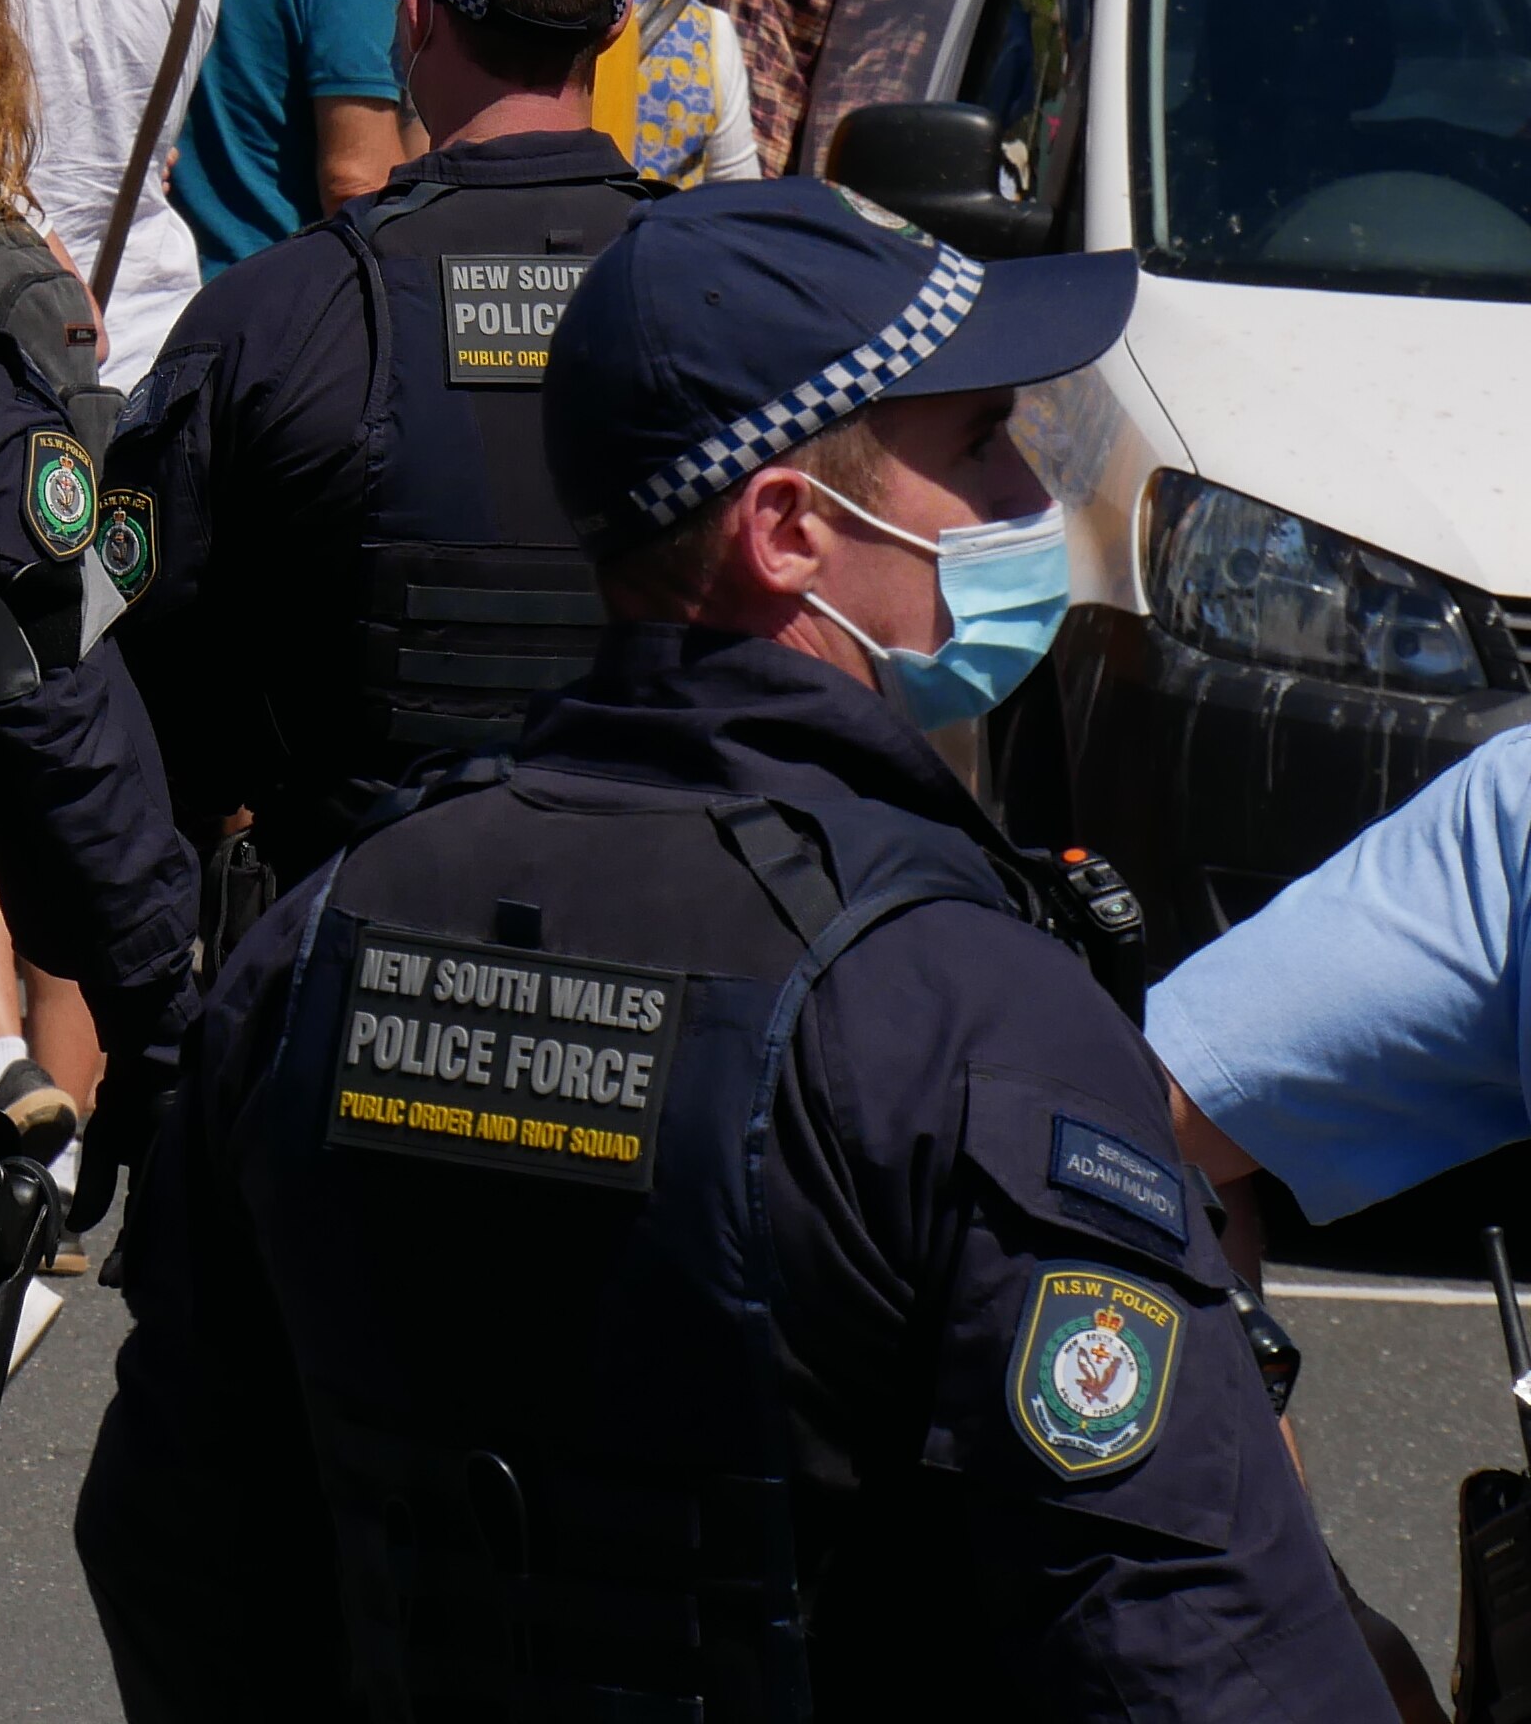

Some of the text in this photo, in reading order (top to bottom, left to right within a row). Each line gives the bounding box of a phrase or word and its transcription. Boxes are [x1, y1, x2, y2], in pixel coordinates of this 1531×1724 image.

[452, 265, 588, 292] NEW SOUT
[458, 350, 549, 368] PUBLIC ORD
[65, 442, 91, 468] POLICE
[359, 948, 666, 1033] NEW SOUTH WALES
[346, 1010, 654, 1109] POLICE FORCE
[340, 1090, 640, 1163] PUBLIC ORDER AND RIOT SQUAD
[1066, 1153, 1177, 1218] ADAM MUNDY
[1053, 1280, 1169, 1328] N.S.W. POLICE
